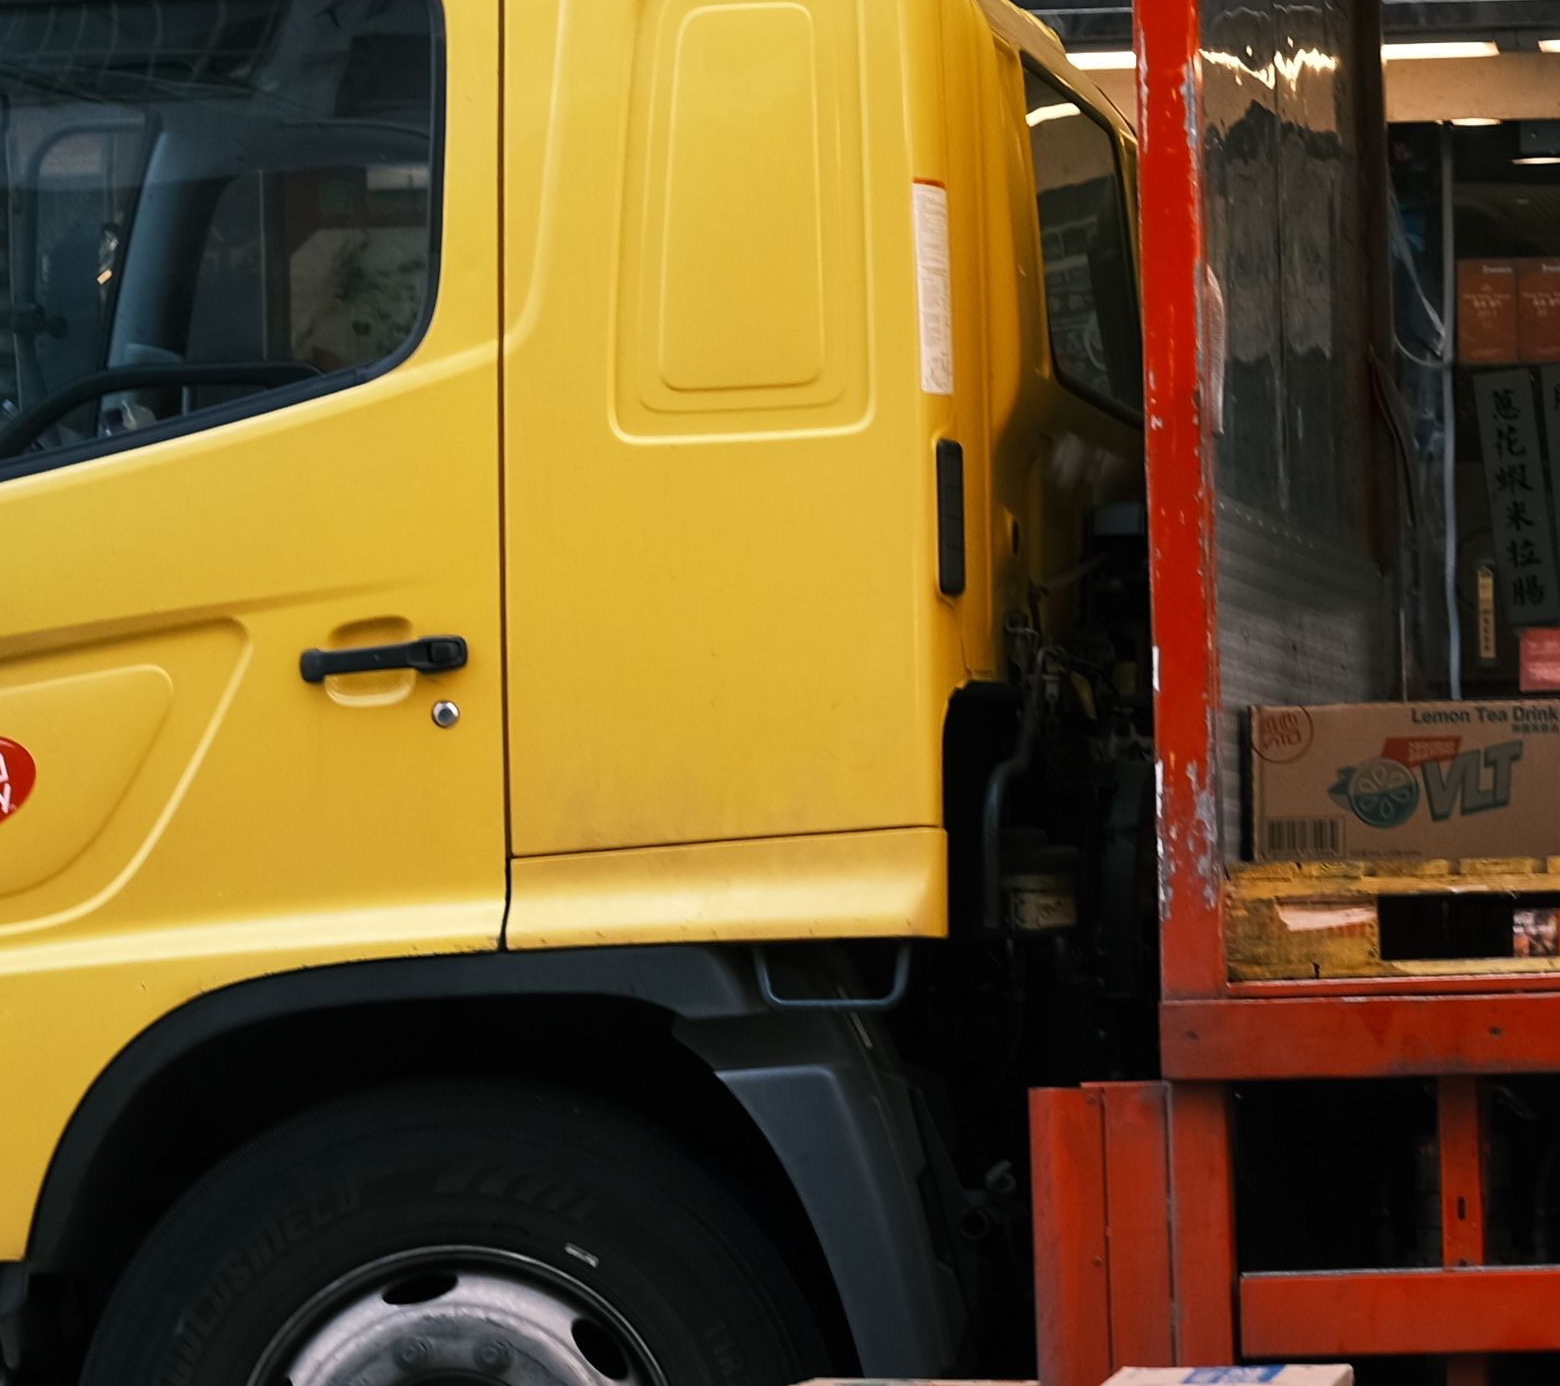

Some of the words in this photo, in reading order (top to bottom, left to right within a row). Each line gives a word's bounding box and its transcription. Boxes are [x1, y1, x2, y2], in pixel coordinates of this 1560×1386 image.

[1411, 706, 1470, 725] Lemon
[1475, 706, 1508, 724] Tea
[1513, 705, 1559, 723] Drink
[1420, 739, 1524, 823] VLT
